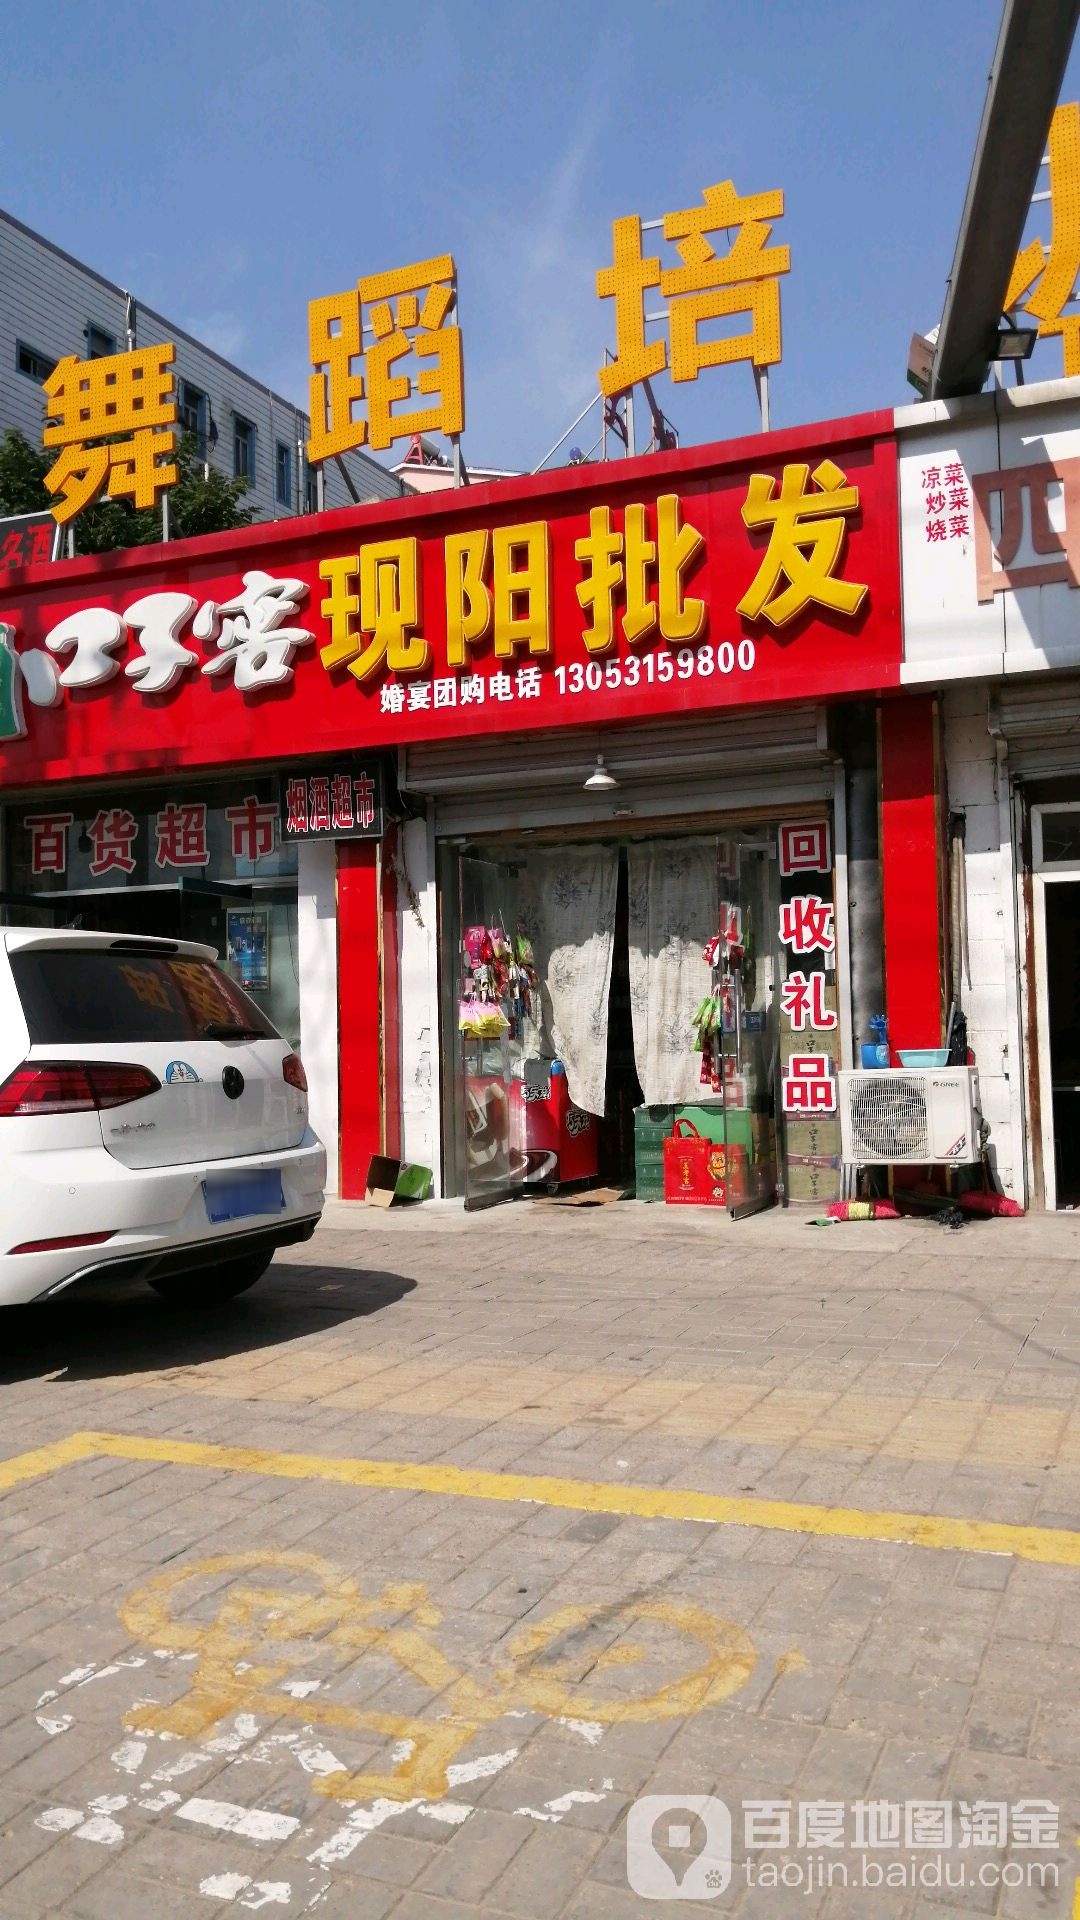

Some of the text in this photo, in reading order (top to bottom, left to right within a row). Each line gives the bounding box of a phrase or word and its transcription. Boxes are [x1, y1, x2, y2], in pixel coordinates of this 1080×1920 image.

[921, 463, 964, 489] 凉菜
[926, 487, 969, 514] 炒菜
[926, 515, 970, 542] 烧菜
[319, 459, 871, 681] 现阳批发
[380, 639, 755, 714] 婚宴团购电话 13053159800
[24, 795, 279, 876] 百货超市
[286, 771, 376, 833] 烟酒超市
[779, 819, 837, 1112] 回收礼品
